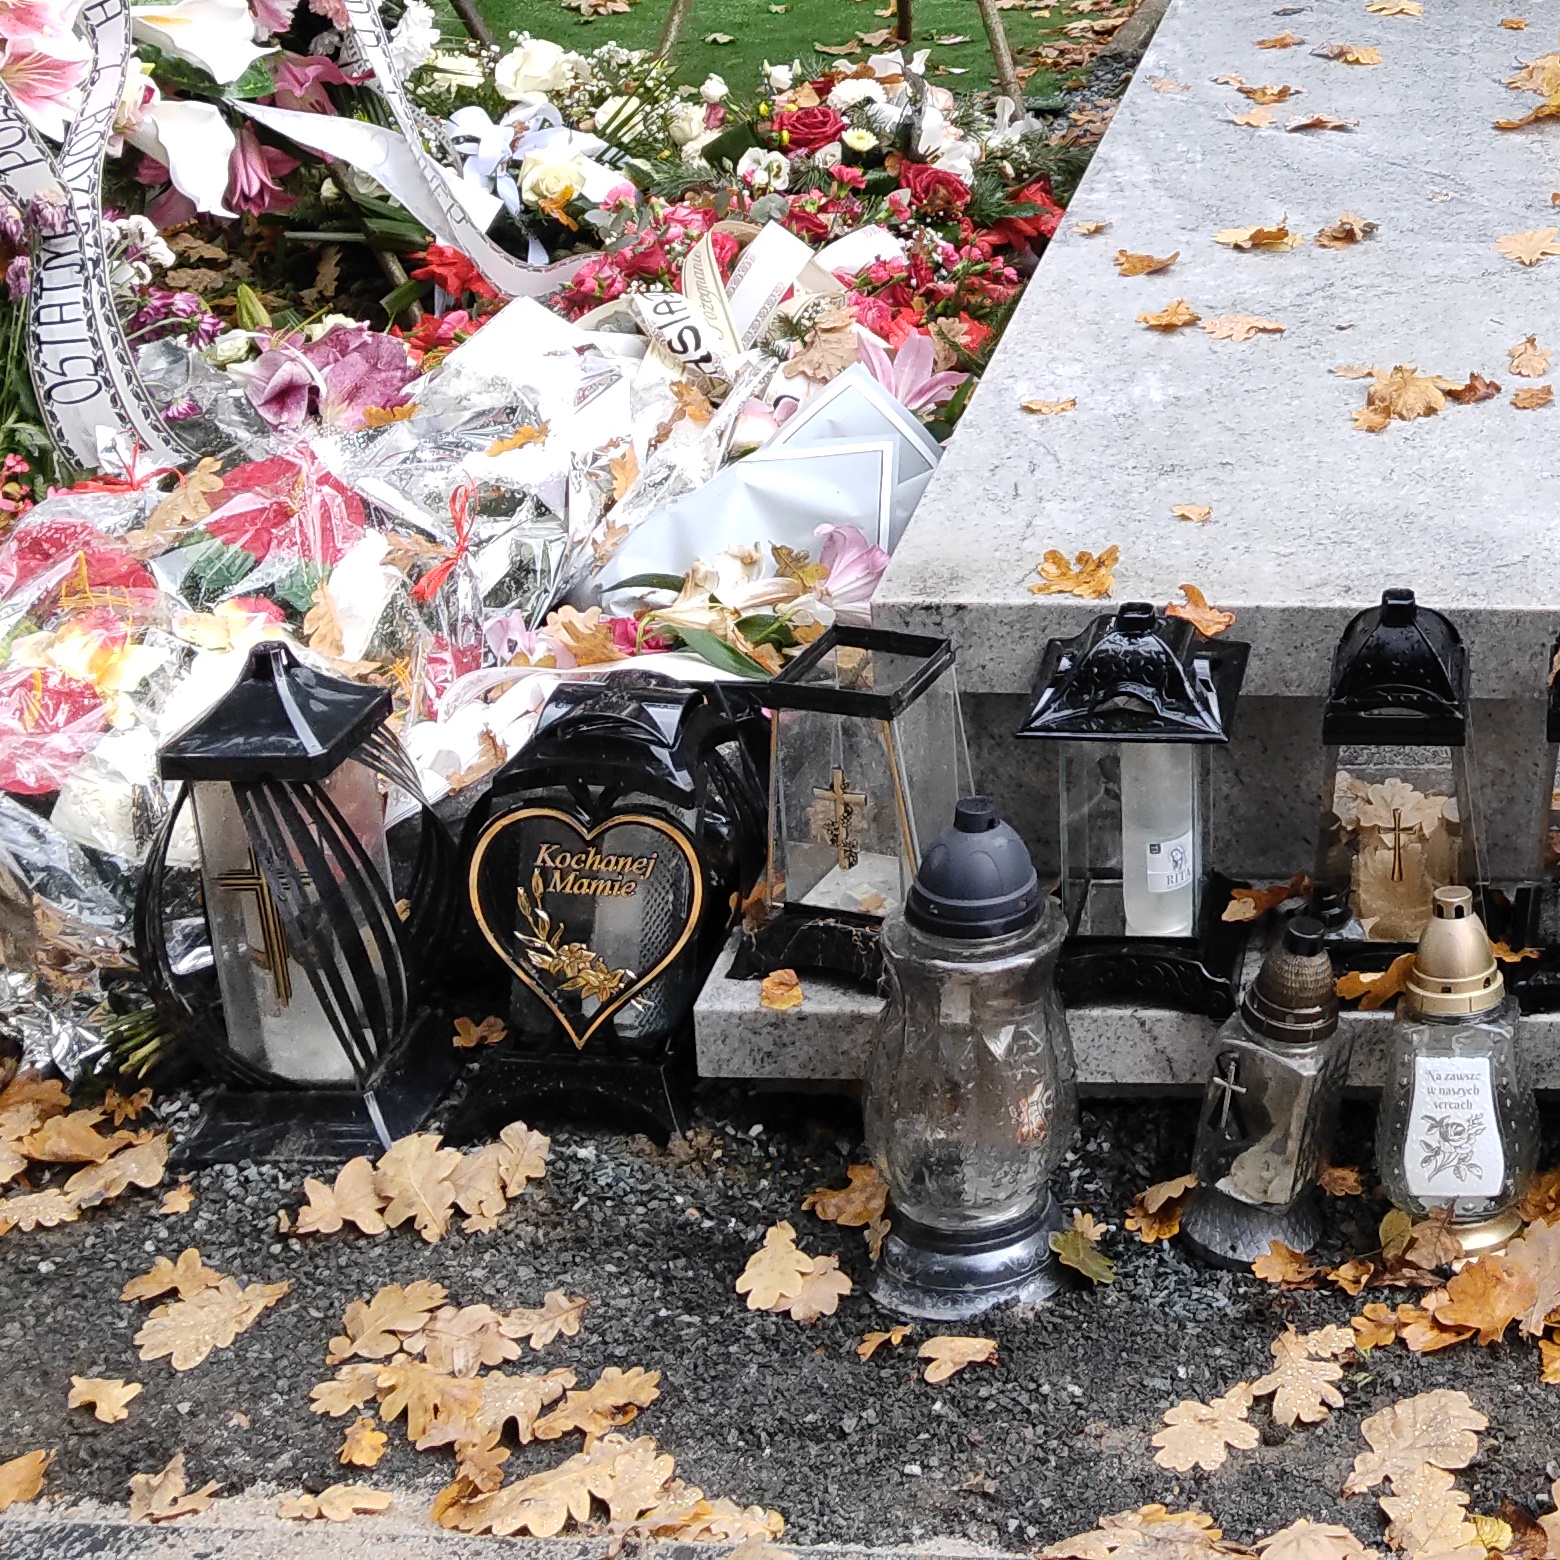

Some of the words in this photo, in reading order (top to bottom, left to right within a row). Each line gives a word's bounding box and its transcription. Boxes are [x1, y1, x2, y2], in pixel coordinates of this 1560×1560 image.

[38, 216, 102, 405] OSTATNI
[534, 843, 658, 879] Kochanej
[1166, 867, 1191, 885] RITA
[546, 870, 636, 898] Mamie
